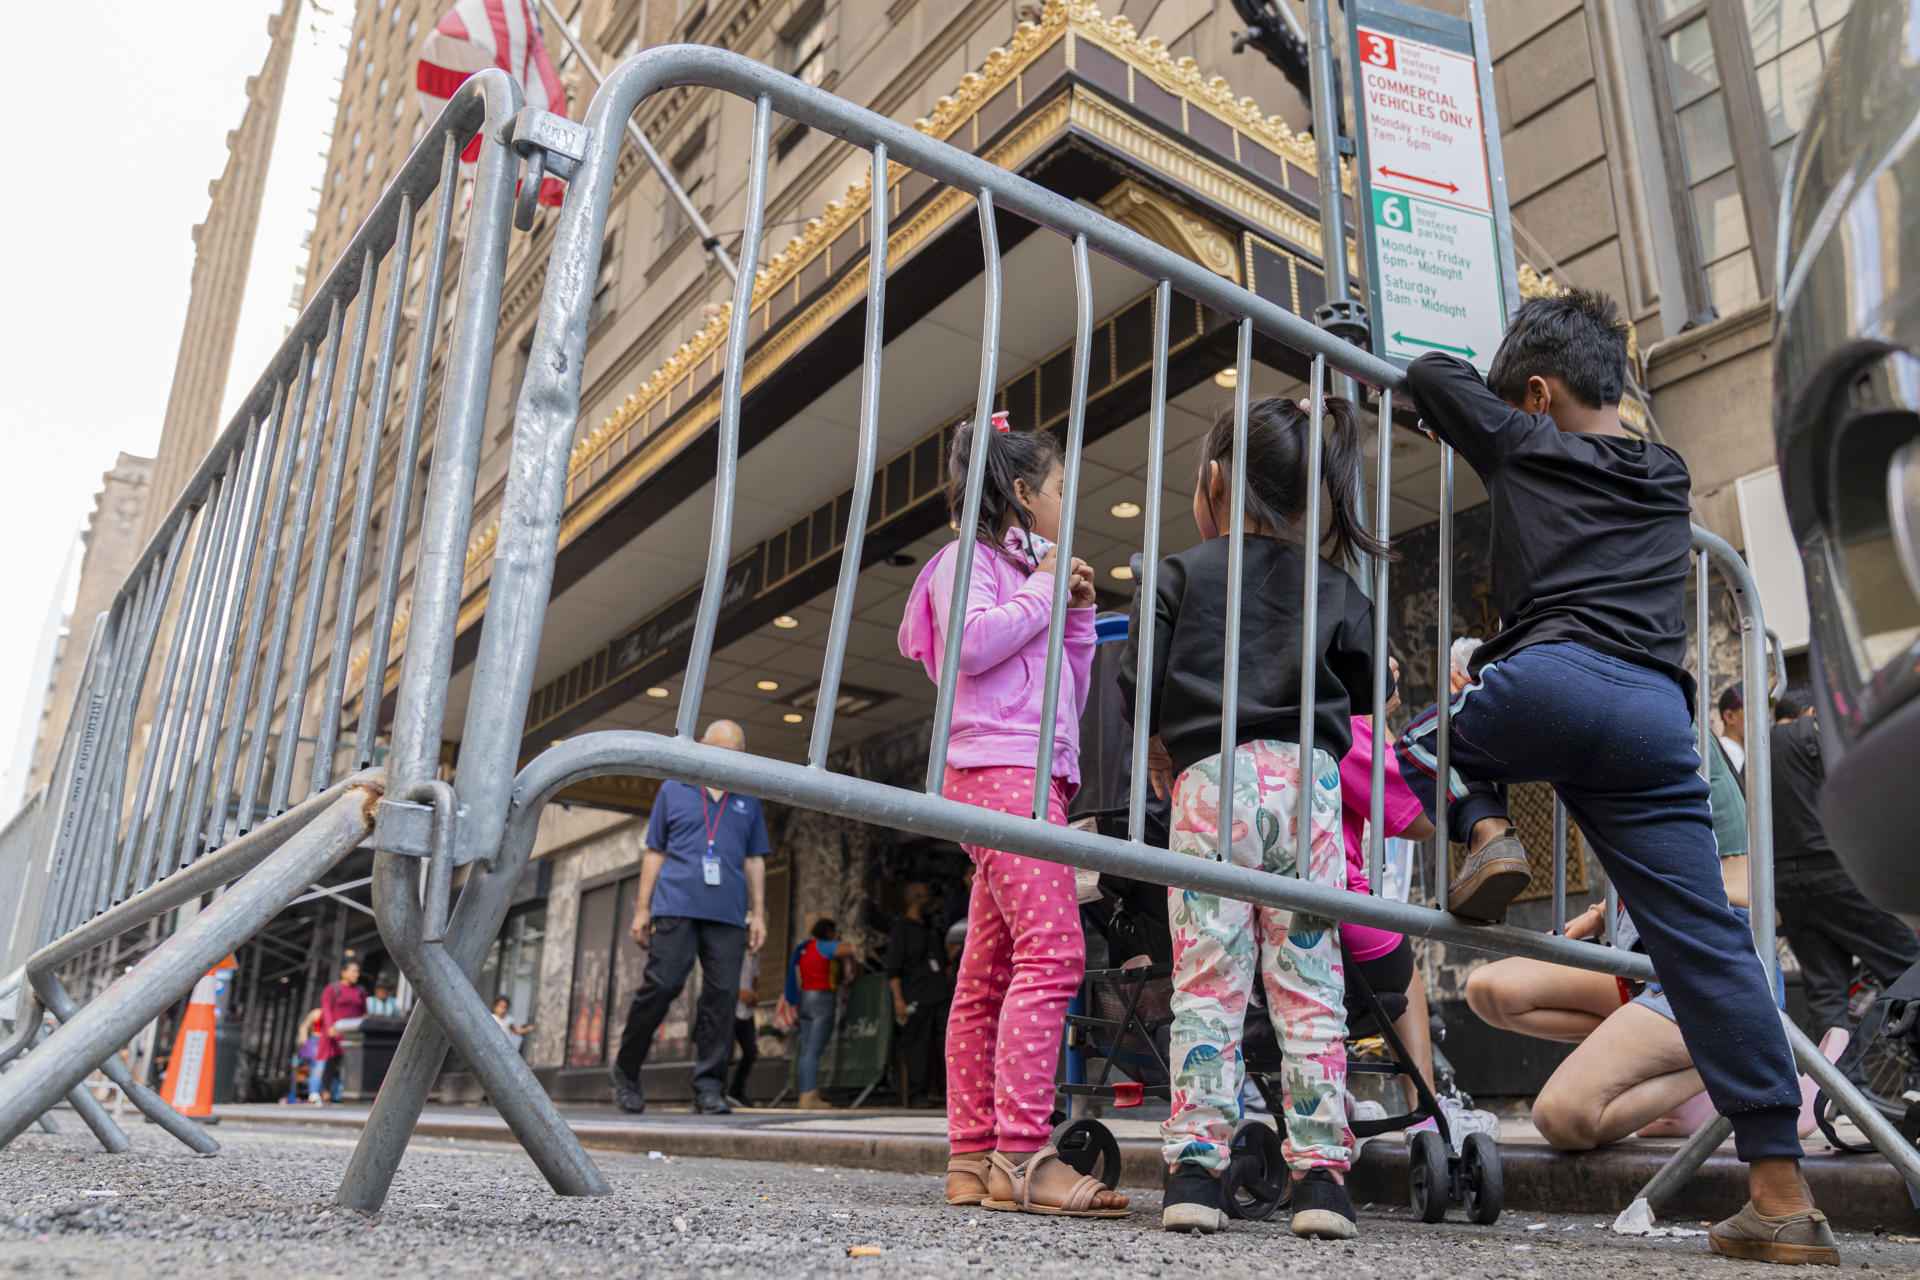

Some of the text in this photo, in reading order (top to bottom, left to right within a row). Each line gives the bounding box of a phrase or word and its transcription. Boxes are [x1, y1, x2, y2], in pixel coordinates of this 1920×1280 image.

[1367, 35, 1389, 67] 3
[1401, 57, 1440, 74] metered
[1402, 67, 1438, 85] parking
[1367, 74, 1458, 109] COMMERCIAL
[1369, 91, 1472, 129] VEHICLES ONLY
[1371, 113, 1411, 134] Monday
[1421, 126, 1453, 145] Friday
[1373, 127, 1396, 143] 7am
[1406, 136, 1431, 151] 6pm
[1382, 197, 1404, 228] 6
[1415, 206, 1437, 218] hour
[1416, 217, 1457, 234] metered
[1417, 228, 1454, 245] parking
[1381, 238, 1426, 259] Monday
[1437, 250, 1471, 271] Friday
[1383, 254, 1408, 268] 6pm
[1418, 260, 1464, 281] Midnight
[1384, 274, 1437, 298] Saturday
[1386, 290, 1411, 305] 8am
[1421, 298, 1467, 319] Midnight
